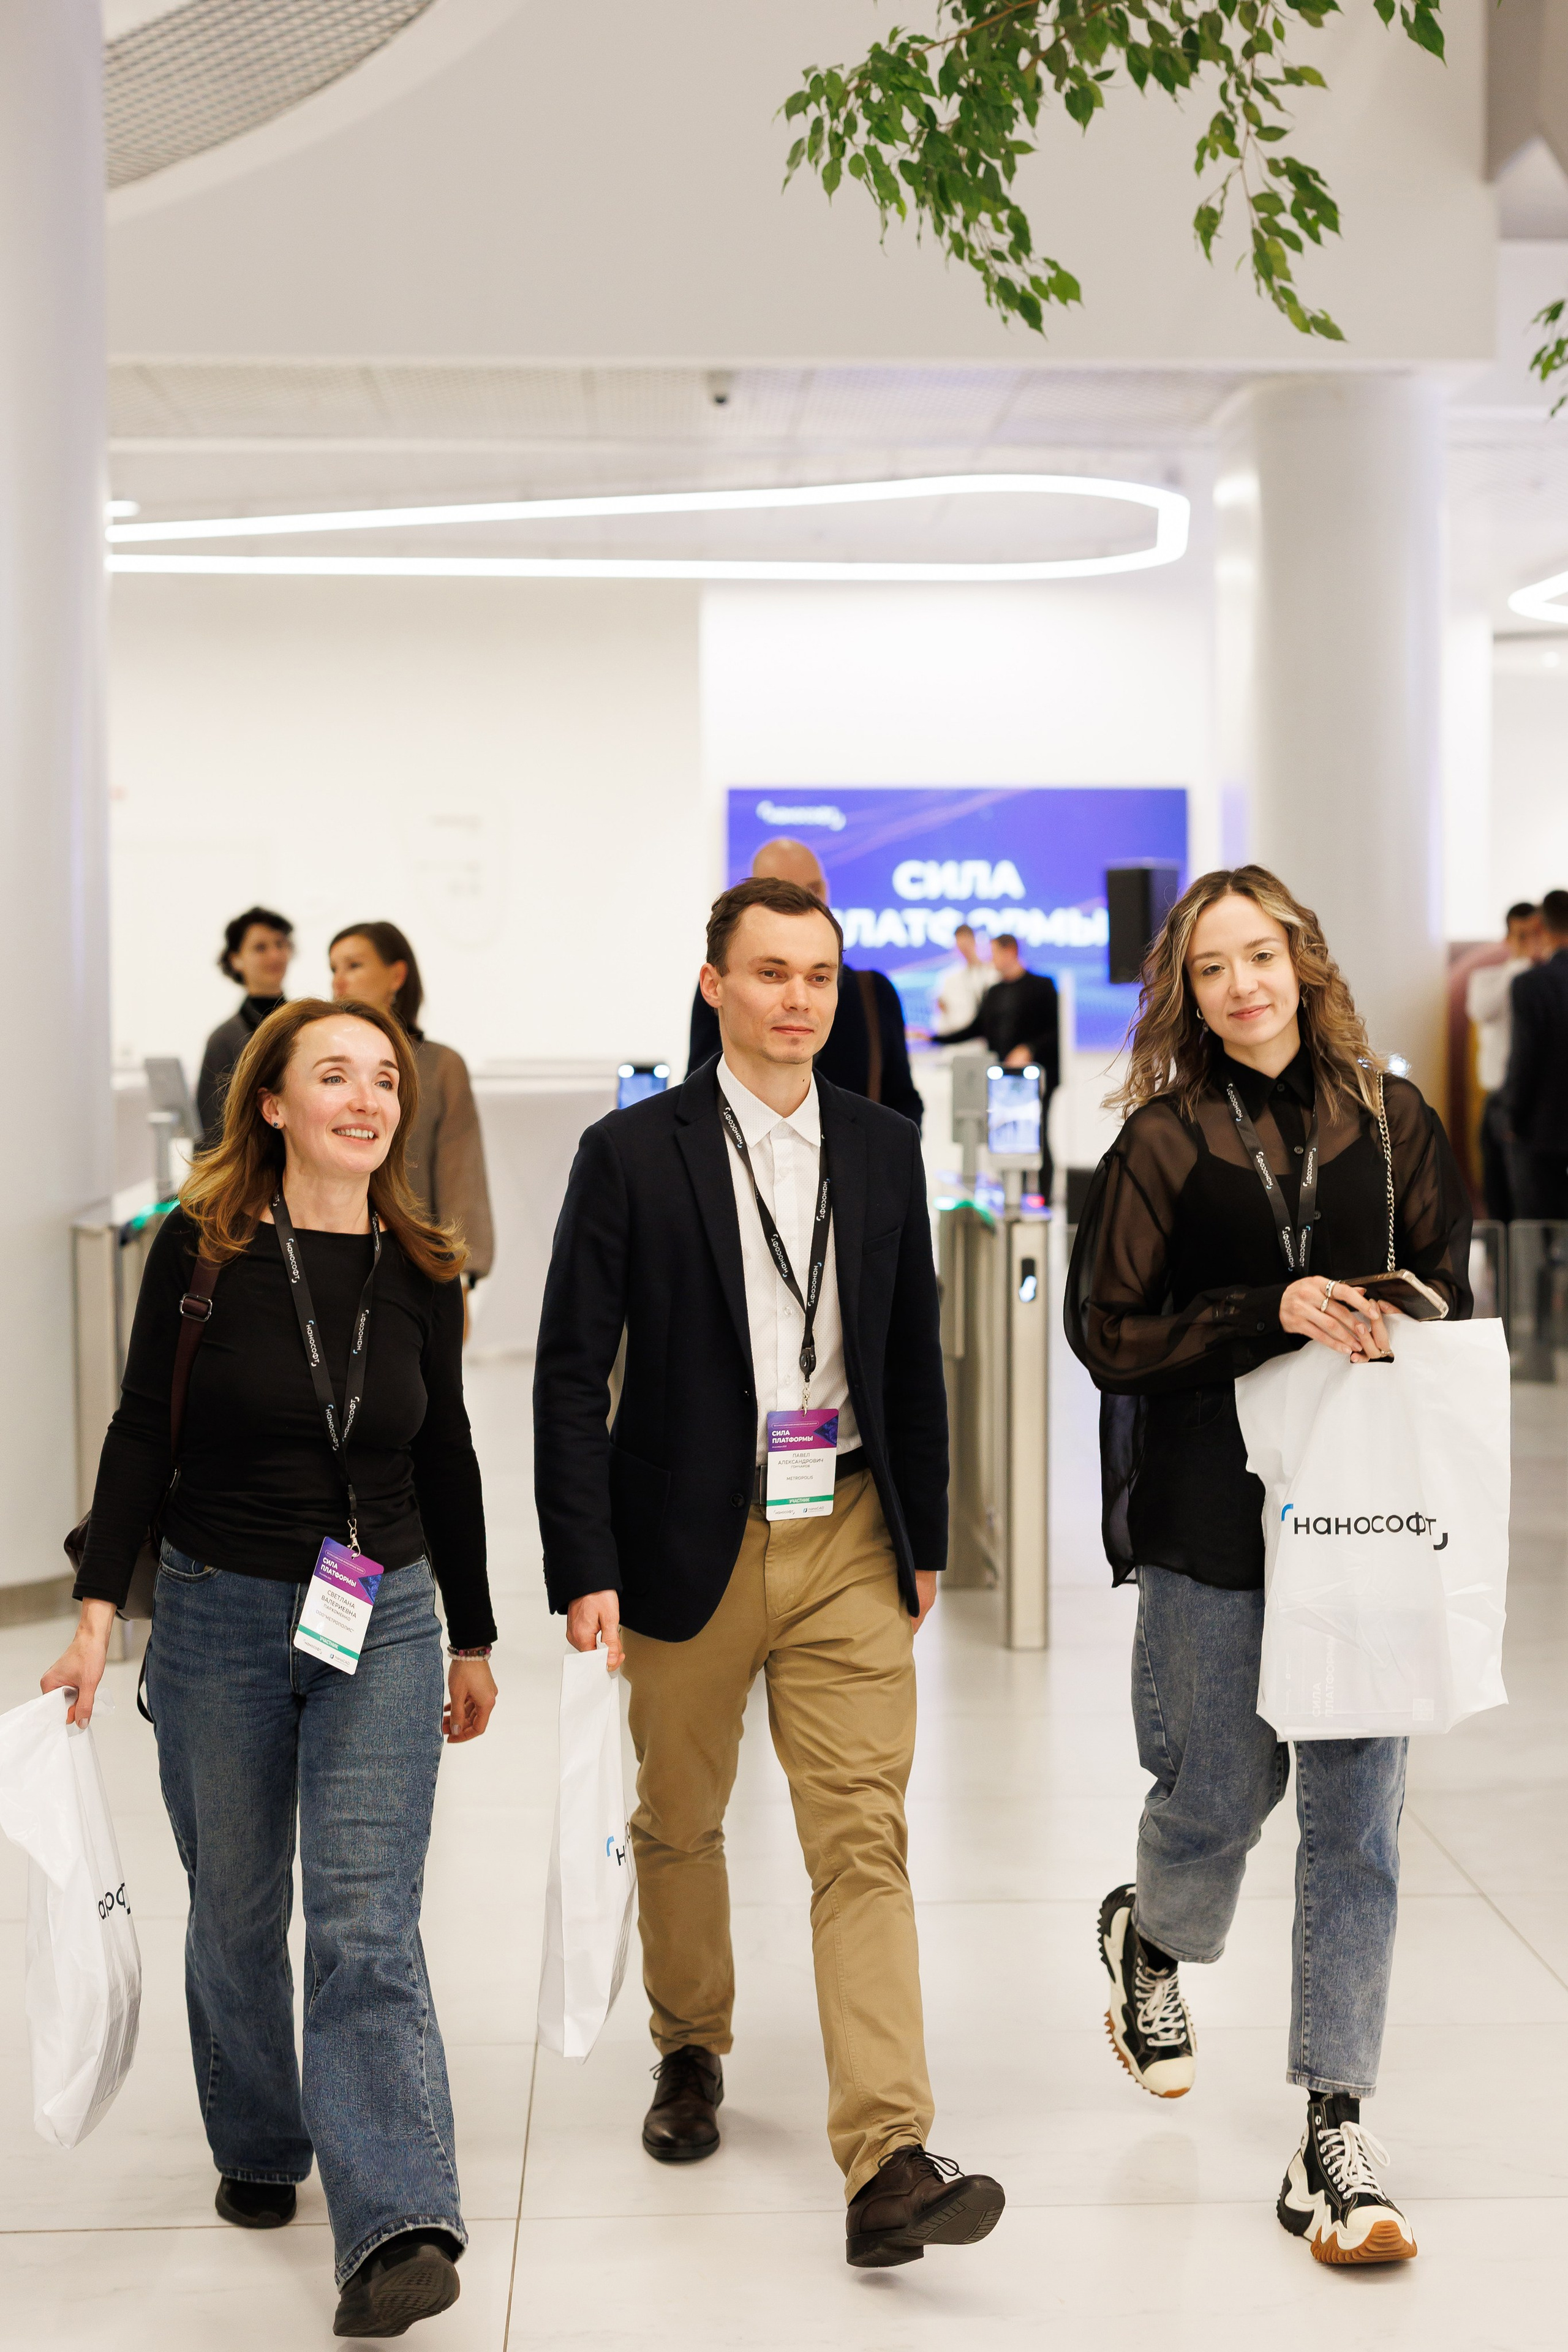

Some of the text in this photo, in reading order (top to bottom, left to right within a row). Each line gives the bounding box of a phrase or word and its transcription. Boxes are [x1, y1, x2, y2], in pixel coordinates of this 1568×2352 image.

[892, 860, 1026, 900] СИЛА
[723, 1110, 743, 1145] нанософт
[1256, 1154, 1273, 1186] нанософт
[286, 1242, 300, 1280] нанософт
[771, 1237, 788, 1275] нанософт
[1282, 1230, 1295, 1268] нанософт
[810, 1265, 819, 1305] нанософт
[306, 1324, 320, 1363] нанософт
[356, 1313, 366, 1351] нанософт
[325, 1408, 339, 1448] нанософт
[343, 1398, 356, 1439] нанософт
[1294, 1511, 1437, 1536] нанософт
[320, 1563, 357, 1588] ПЛАТФОРМЫ
[323, 1556, 338, 1570] СИЛА
[321, 1595, 356, 1619] ВАЛЕРИЕВНА
[327, 1589, 355, 1609] СВЕТЛАНА
[319, 1635, 339, 1650] УЧАСТНИК
